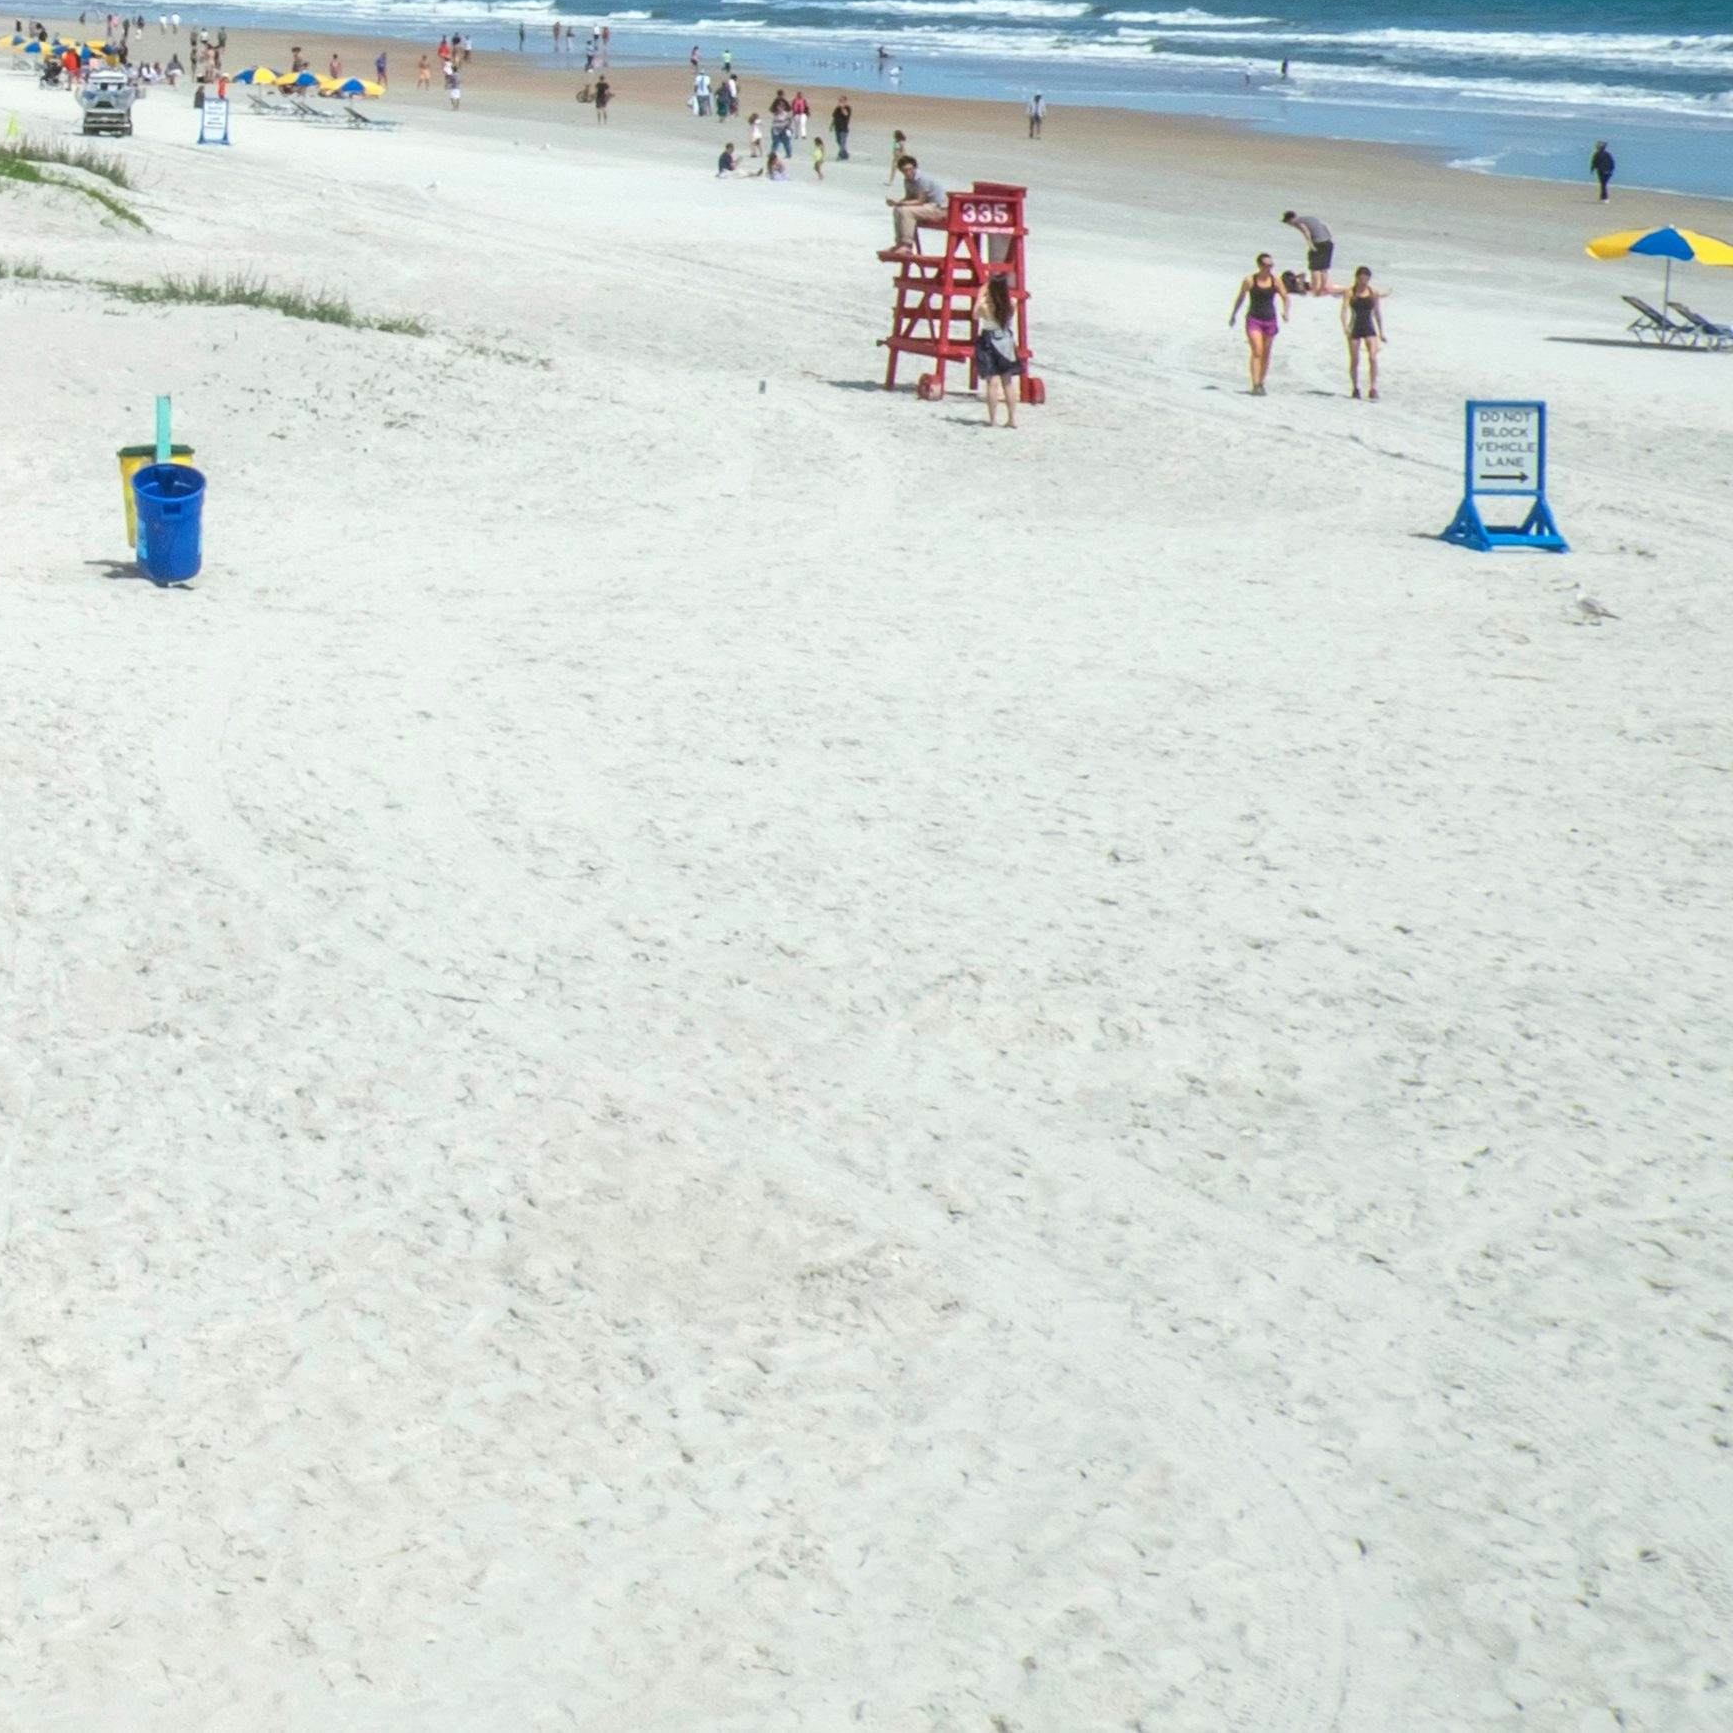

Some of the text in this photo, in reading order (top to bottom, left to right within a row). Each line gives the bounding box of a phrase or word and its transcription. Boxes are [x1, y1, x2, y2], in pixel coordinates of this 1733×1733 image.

[962, 202, 1009, 224] 335
[1479, 409, 1532, 423] DO NOT
[1481, 426, 1529, 438] BLOCK
[1475, 441, 1537, 454] VEHICLE
[1485, 456, 1525, 468] LANE
